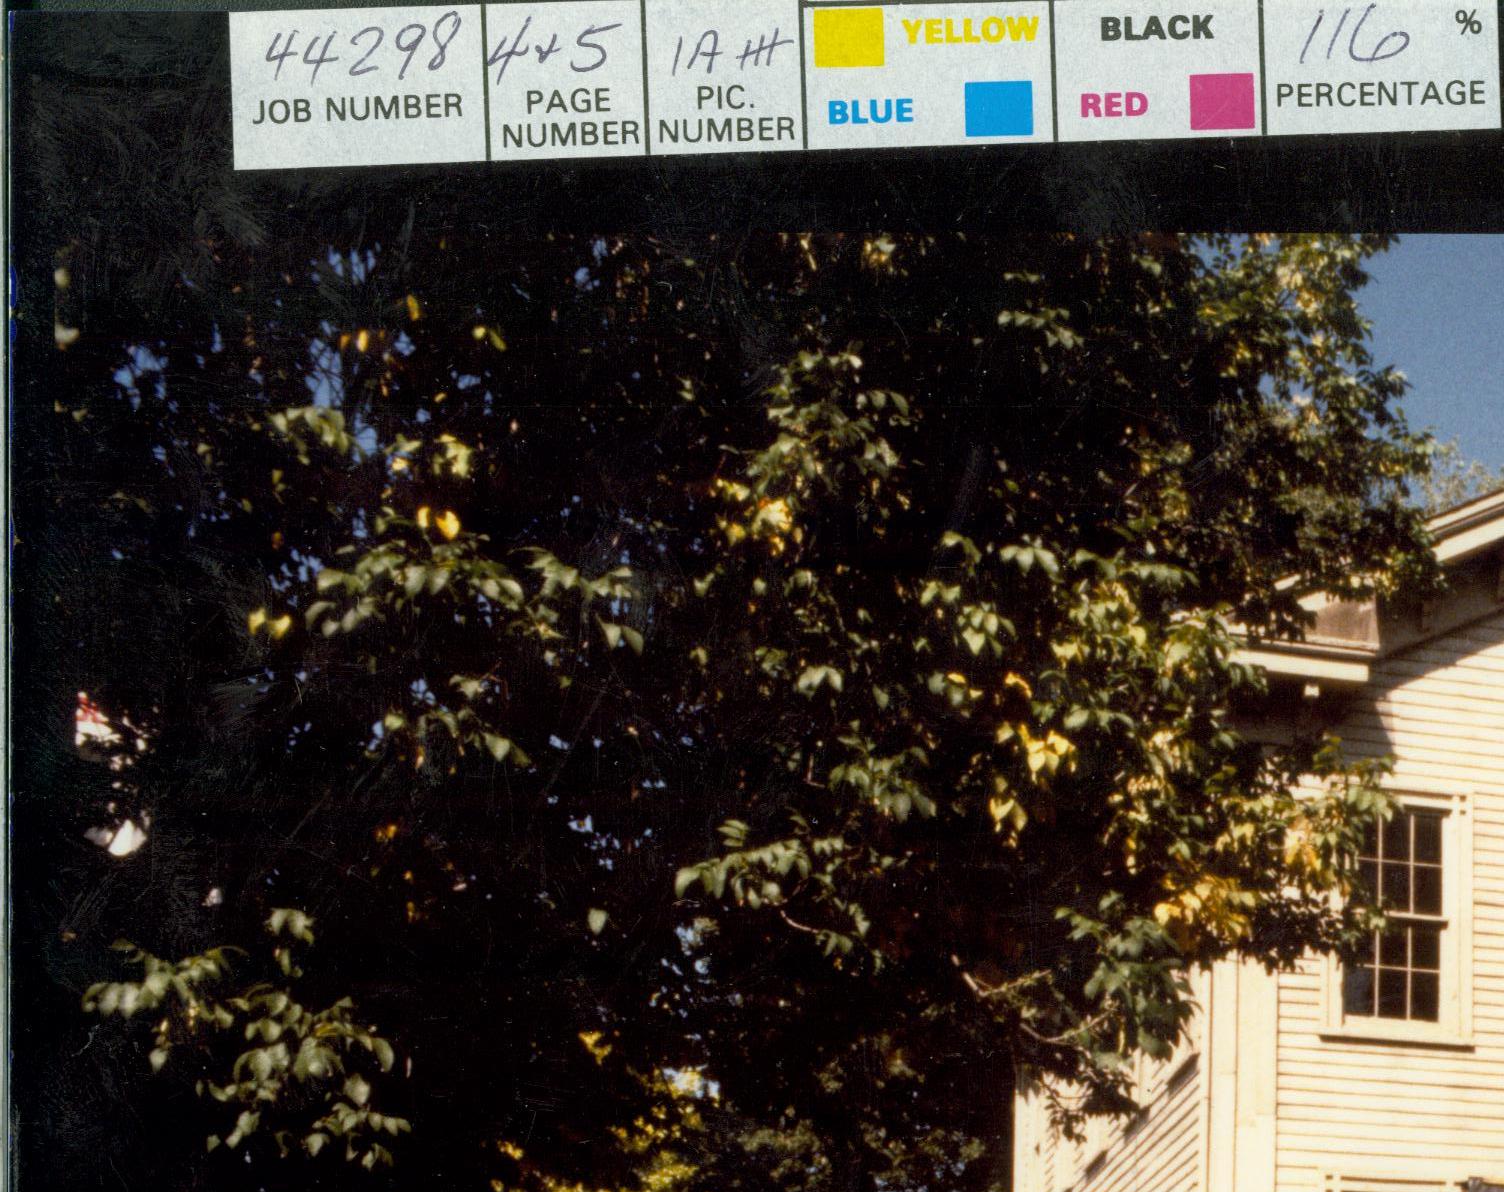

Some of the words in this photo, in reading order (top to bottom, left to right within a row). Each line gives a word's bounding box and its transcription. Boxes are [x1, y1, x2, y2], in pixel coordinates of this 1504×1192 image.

[902, 16, 1038, 45] YELLOW
[1101, 15, 1214, 41] BLACK
[1300, 3, 1409, 64] 116
[1456, 9, 1482, 35] %
[264, 11, 462, 84] 44298
[527, 88, 610, 114] PAGE
[698, 85, 754, 109] PIC.
[1082, 92, 1148, 117] RED
[1277, 80, 1485, 107] PERCENTAGE
[253, 99, 311, 124] JOB
[327, 94, 462, 121] NUMBER
[829, 99, 913, 124] BLUE
[503, 121, 639, 148] NUMBER
[660, 117, 794, 143] NUMBER
